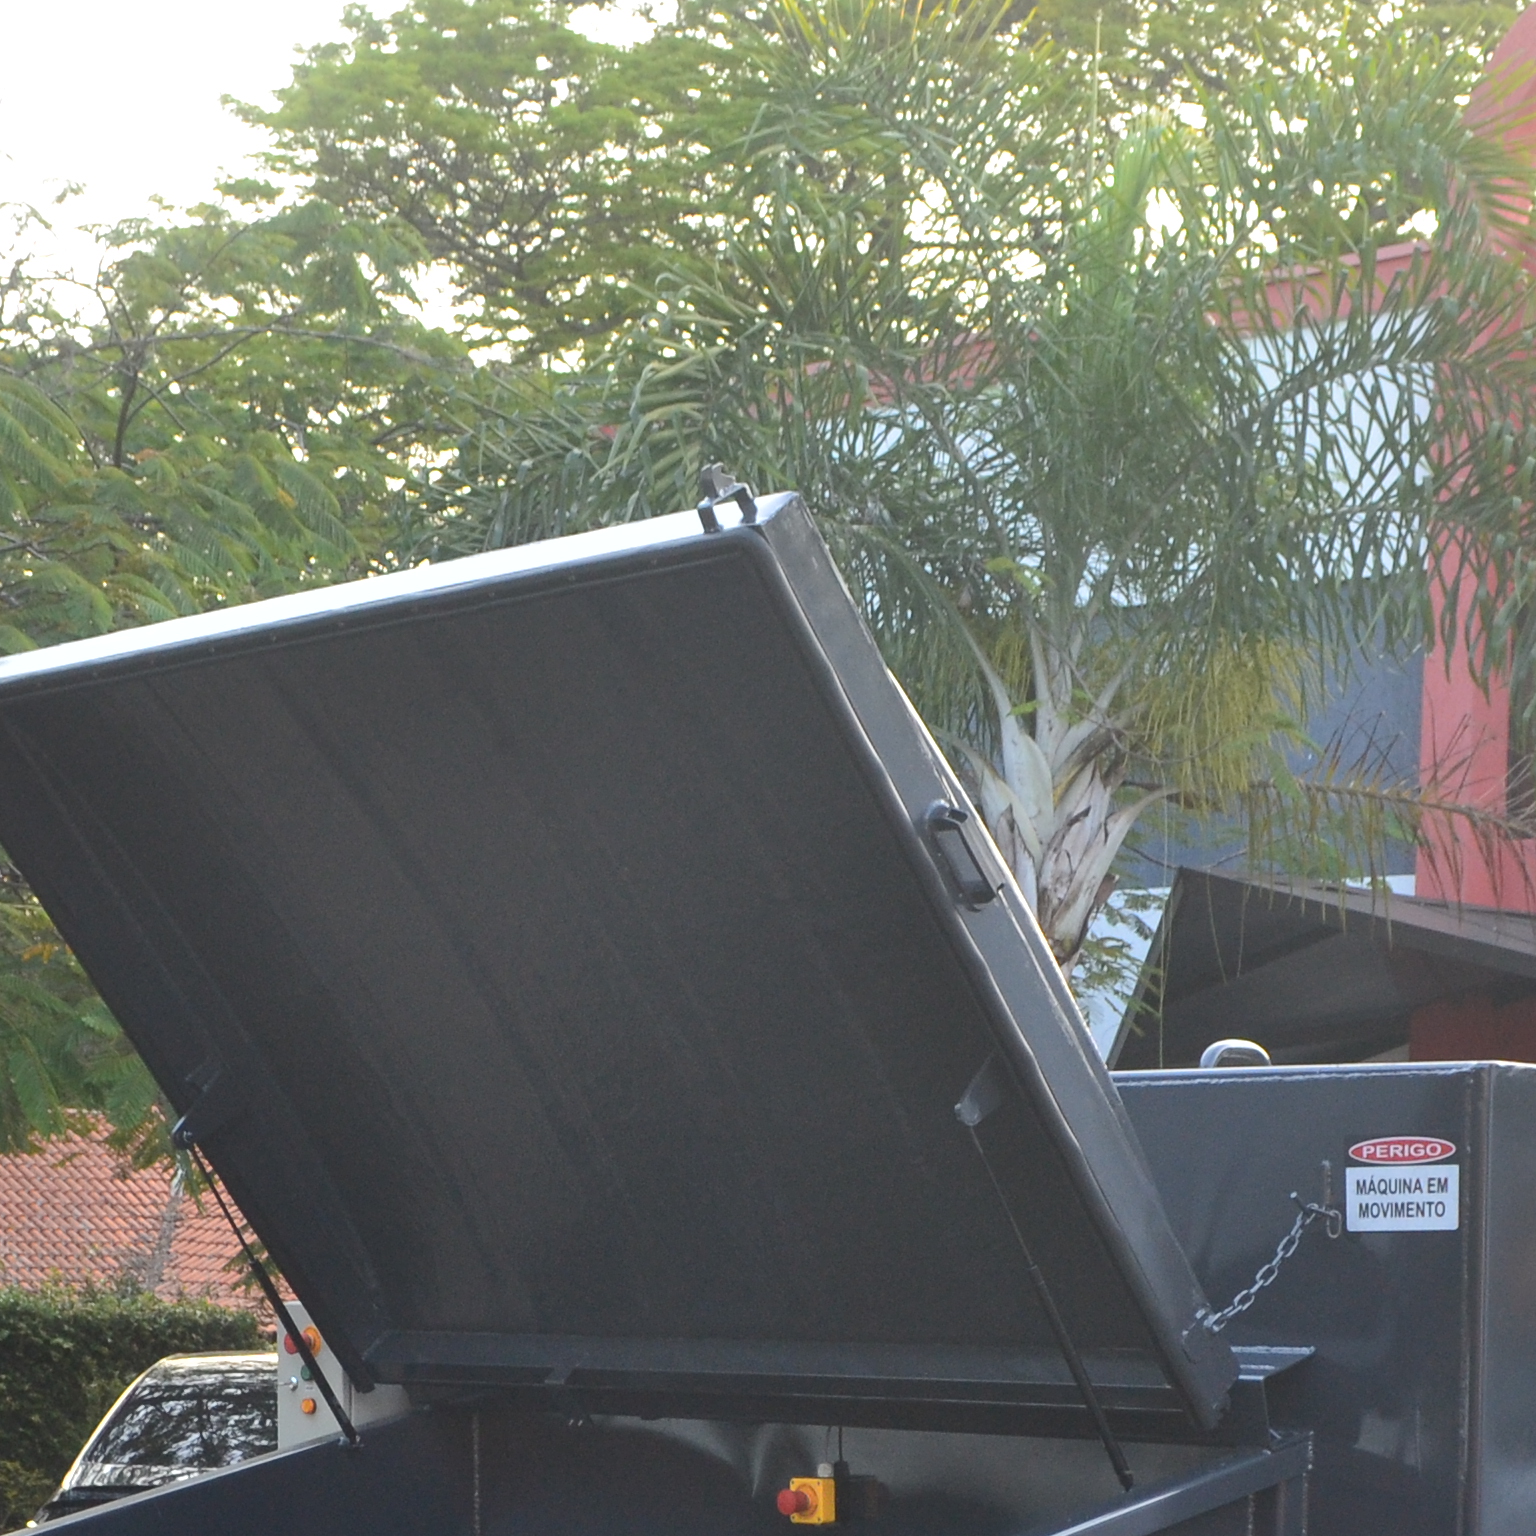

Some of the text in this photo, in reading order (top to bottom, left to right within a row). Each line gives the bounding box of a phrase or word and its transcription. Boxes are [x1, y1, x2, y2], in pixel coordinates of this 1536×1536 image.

[1362, 1143, 1442, 1158] PERIGO
[1356, 1175, 1448, 1195] MÁQUINA EM
[1358, 1201, 1446, 1218] MOVIMENTO
